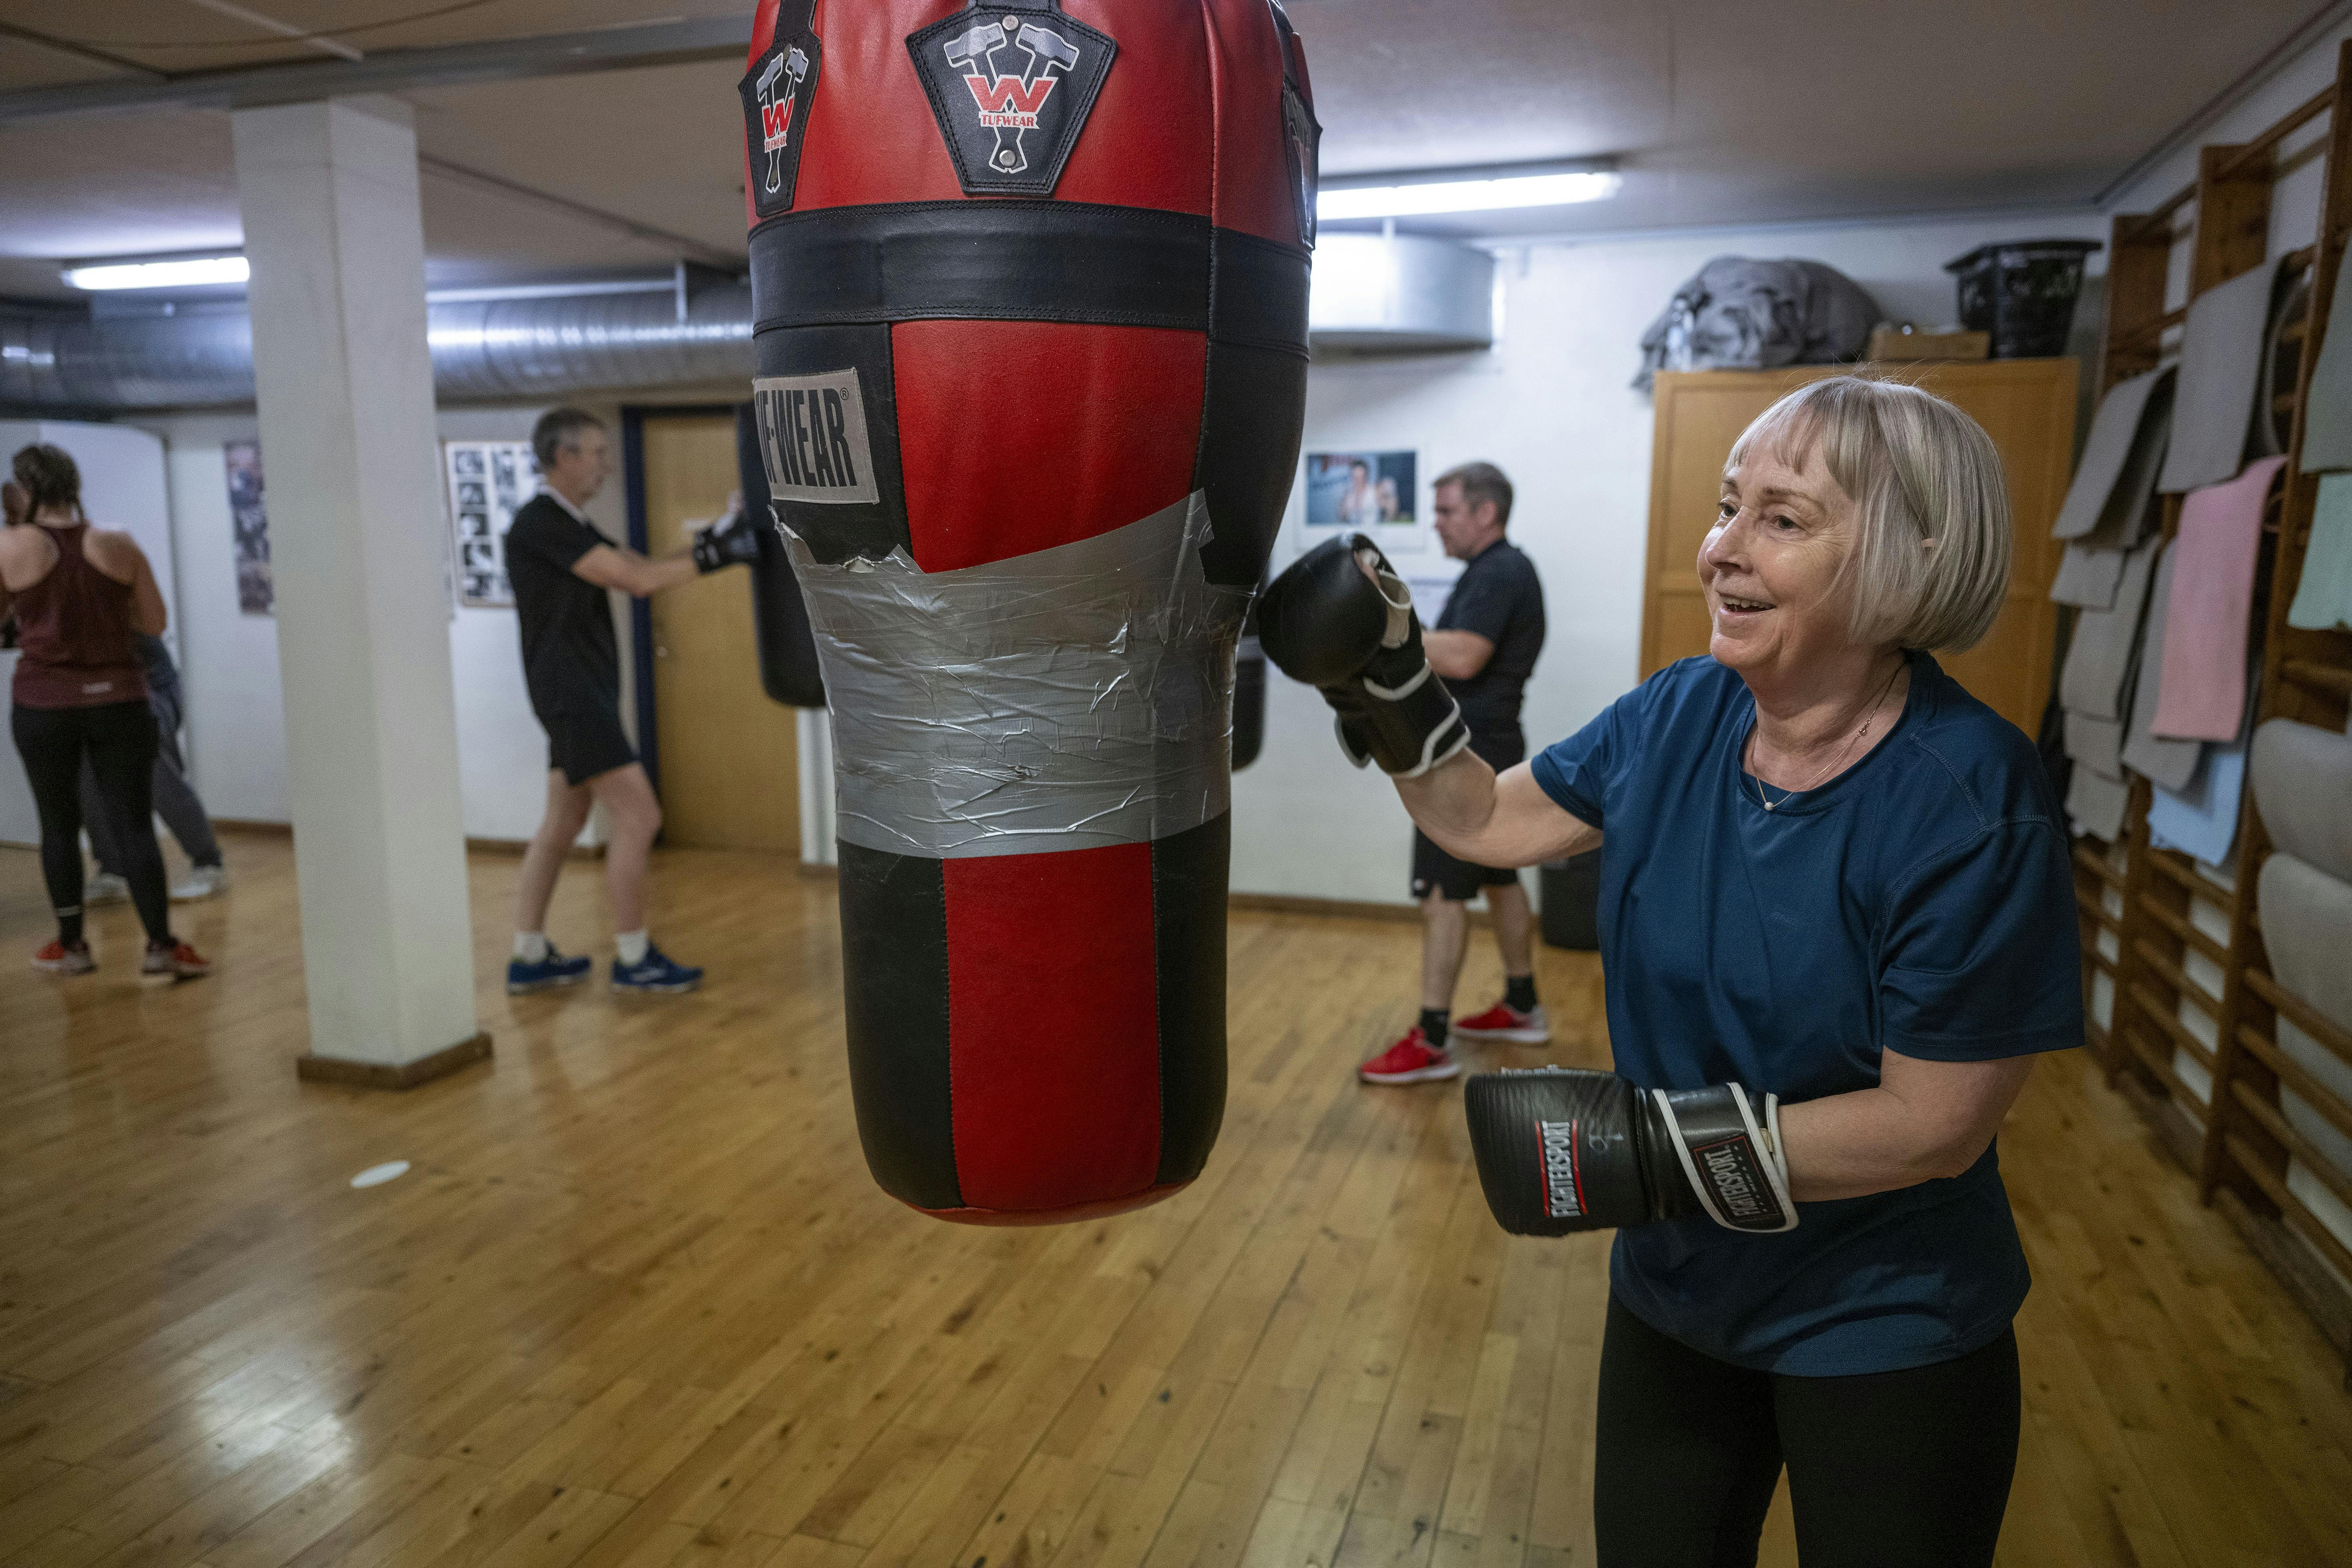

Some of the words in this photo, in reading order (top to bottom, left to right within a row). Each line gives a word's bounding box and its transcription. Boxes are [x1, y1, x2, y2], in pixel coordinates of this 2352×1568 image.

[981, 115, 1034, 127] TUFWEAR
[1542, 1121, 1581, 1217] FIGHTERSPORT
[1704, 1149, 1761, 1216] FIGHTERSPORT
